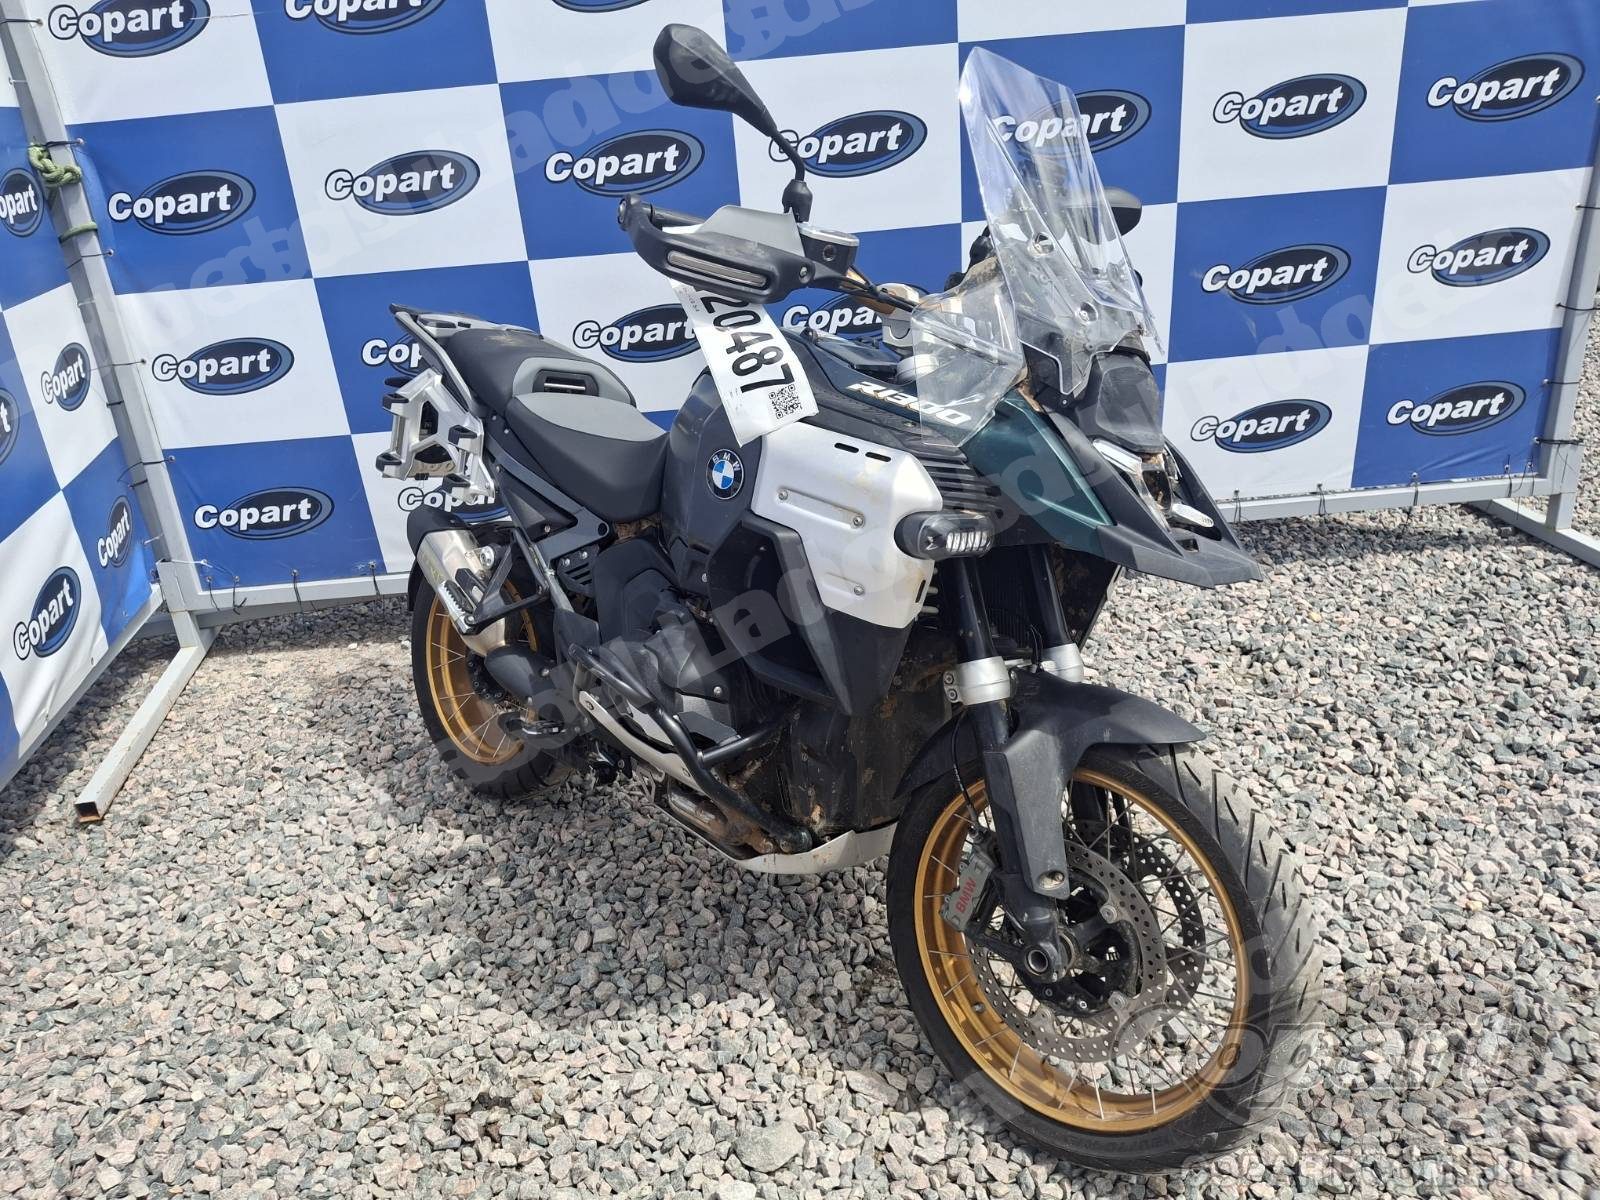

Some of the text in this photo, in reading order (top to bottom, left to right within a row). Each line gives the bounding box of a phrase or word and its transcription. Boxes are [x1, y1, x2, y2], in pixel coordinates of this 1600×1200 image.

[48, 1, 186, 42] Copart
[1213, 84, 1345, 126] Copart
[1427, 66, 1562, 109] Copart
[769, 123, 902, 164] Copart
[987, 104, 1127, 148] Copart
[325, 161, 456, 200] Copart
[545, 143, 680, 184] Copart
[0, 184, 38, 224] opart
[107, 183, 233, 224] Copart
[1202, 255, 1329, 294] Copart
[1407, 238, 1529, 275] Copart
[573, 319, 697, 351] Copart
[783, 304, 882, 335] Copa
[362, 338, 421, 367] Cop
[700, 296, 795, 393] 20487
[41, 353, 86, 404] Copart
[152, 347, 272, 383] Copart
[847, 381, 972, 425] R1300
[1387, 391, 1506, 427] Copart
[1191, 408, 1311, 443] Copart
[712, 452, 741, 471] BMW
[195, 497, 313, 532] Copart
[98, 506, 130, 568] Copart
[14, 577, 74, 660] Copart
[956, 878, 977, 913] BMW
